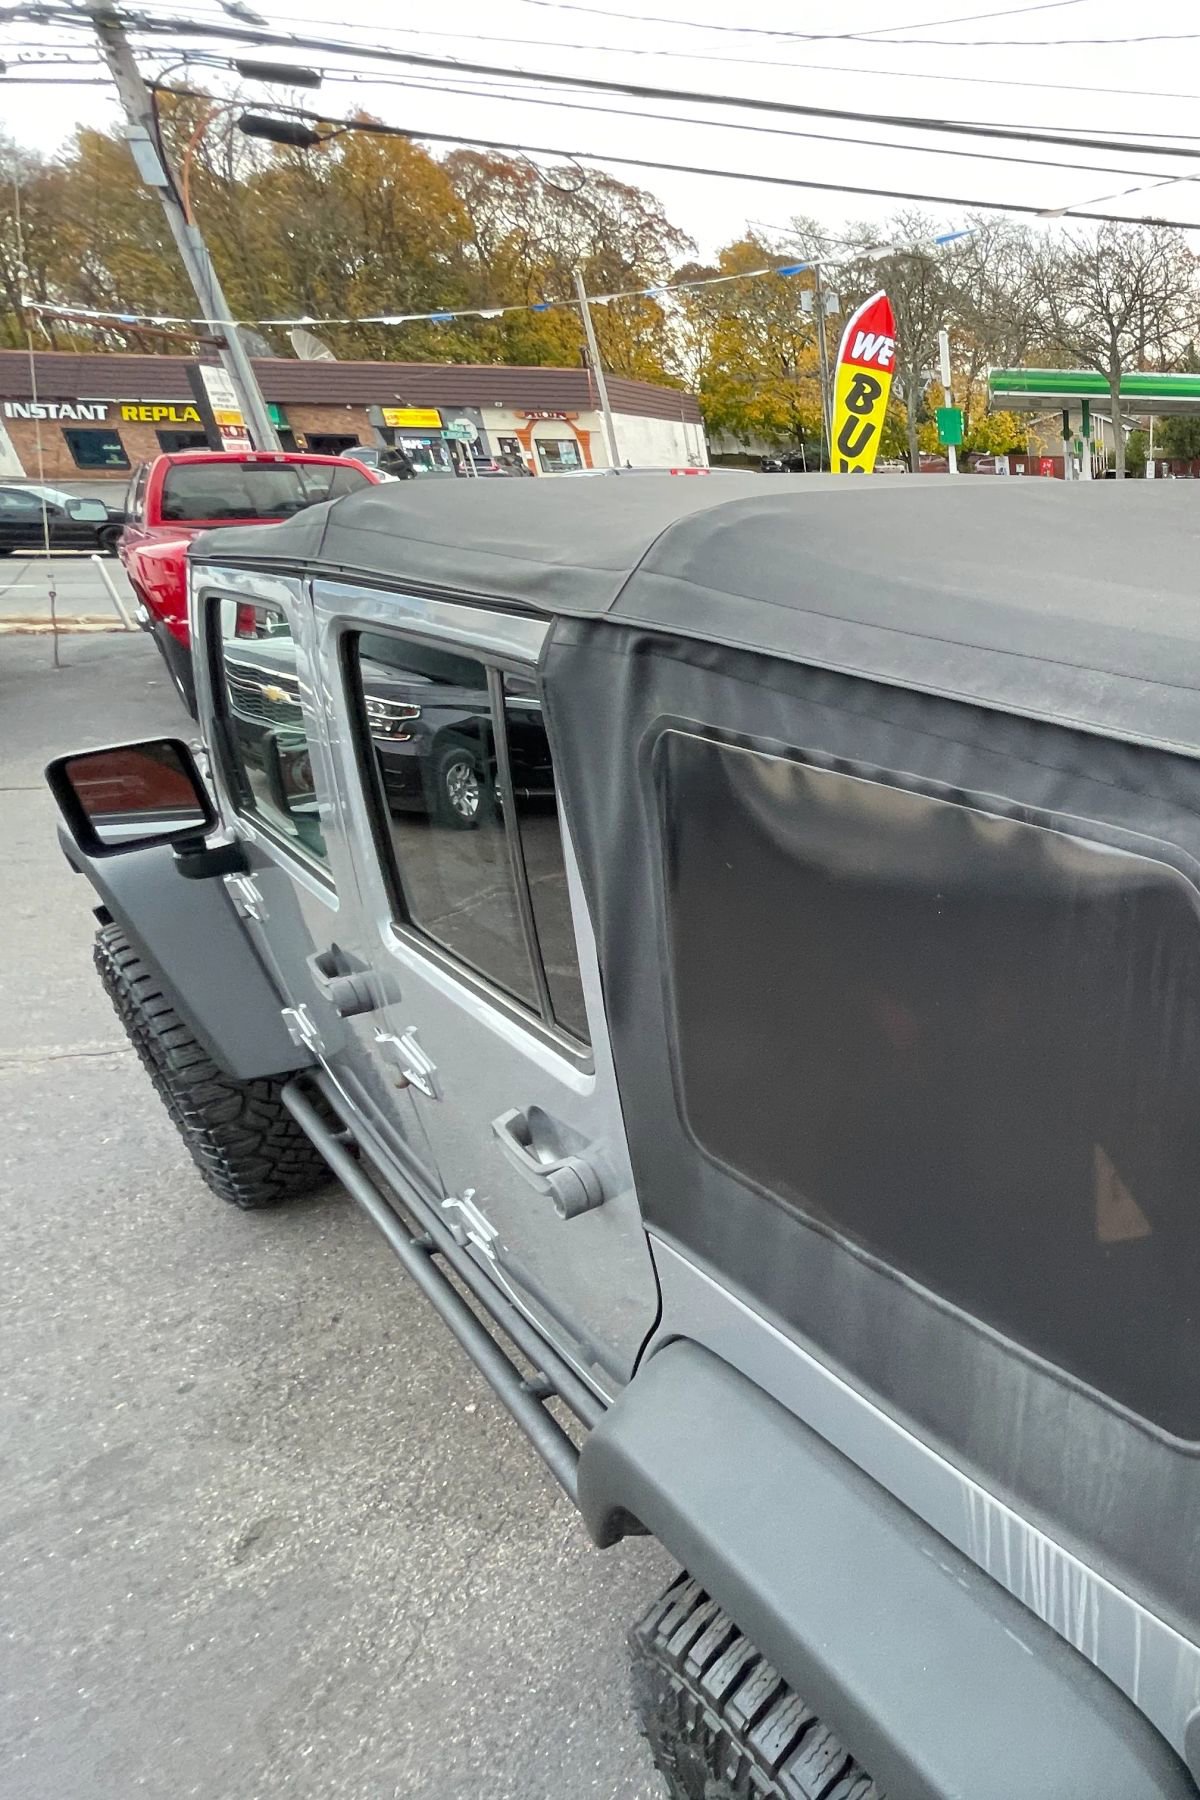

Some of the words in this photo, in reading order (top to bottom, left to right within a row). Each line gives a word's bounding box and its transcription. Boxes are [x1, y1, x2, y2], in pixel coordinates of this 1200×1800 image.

[851, 330, 894, 367] WE
[4, 402, 109, 421] INSTANT
[120, 405, 201, 423] REPLA
